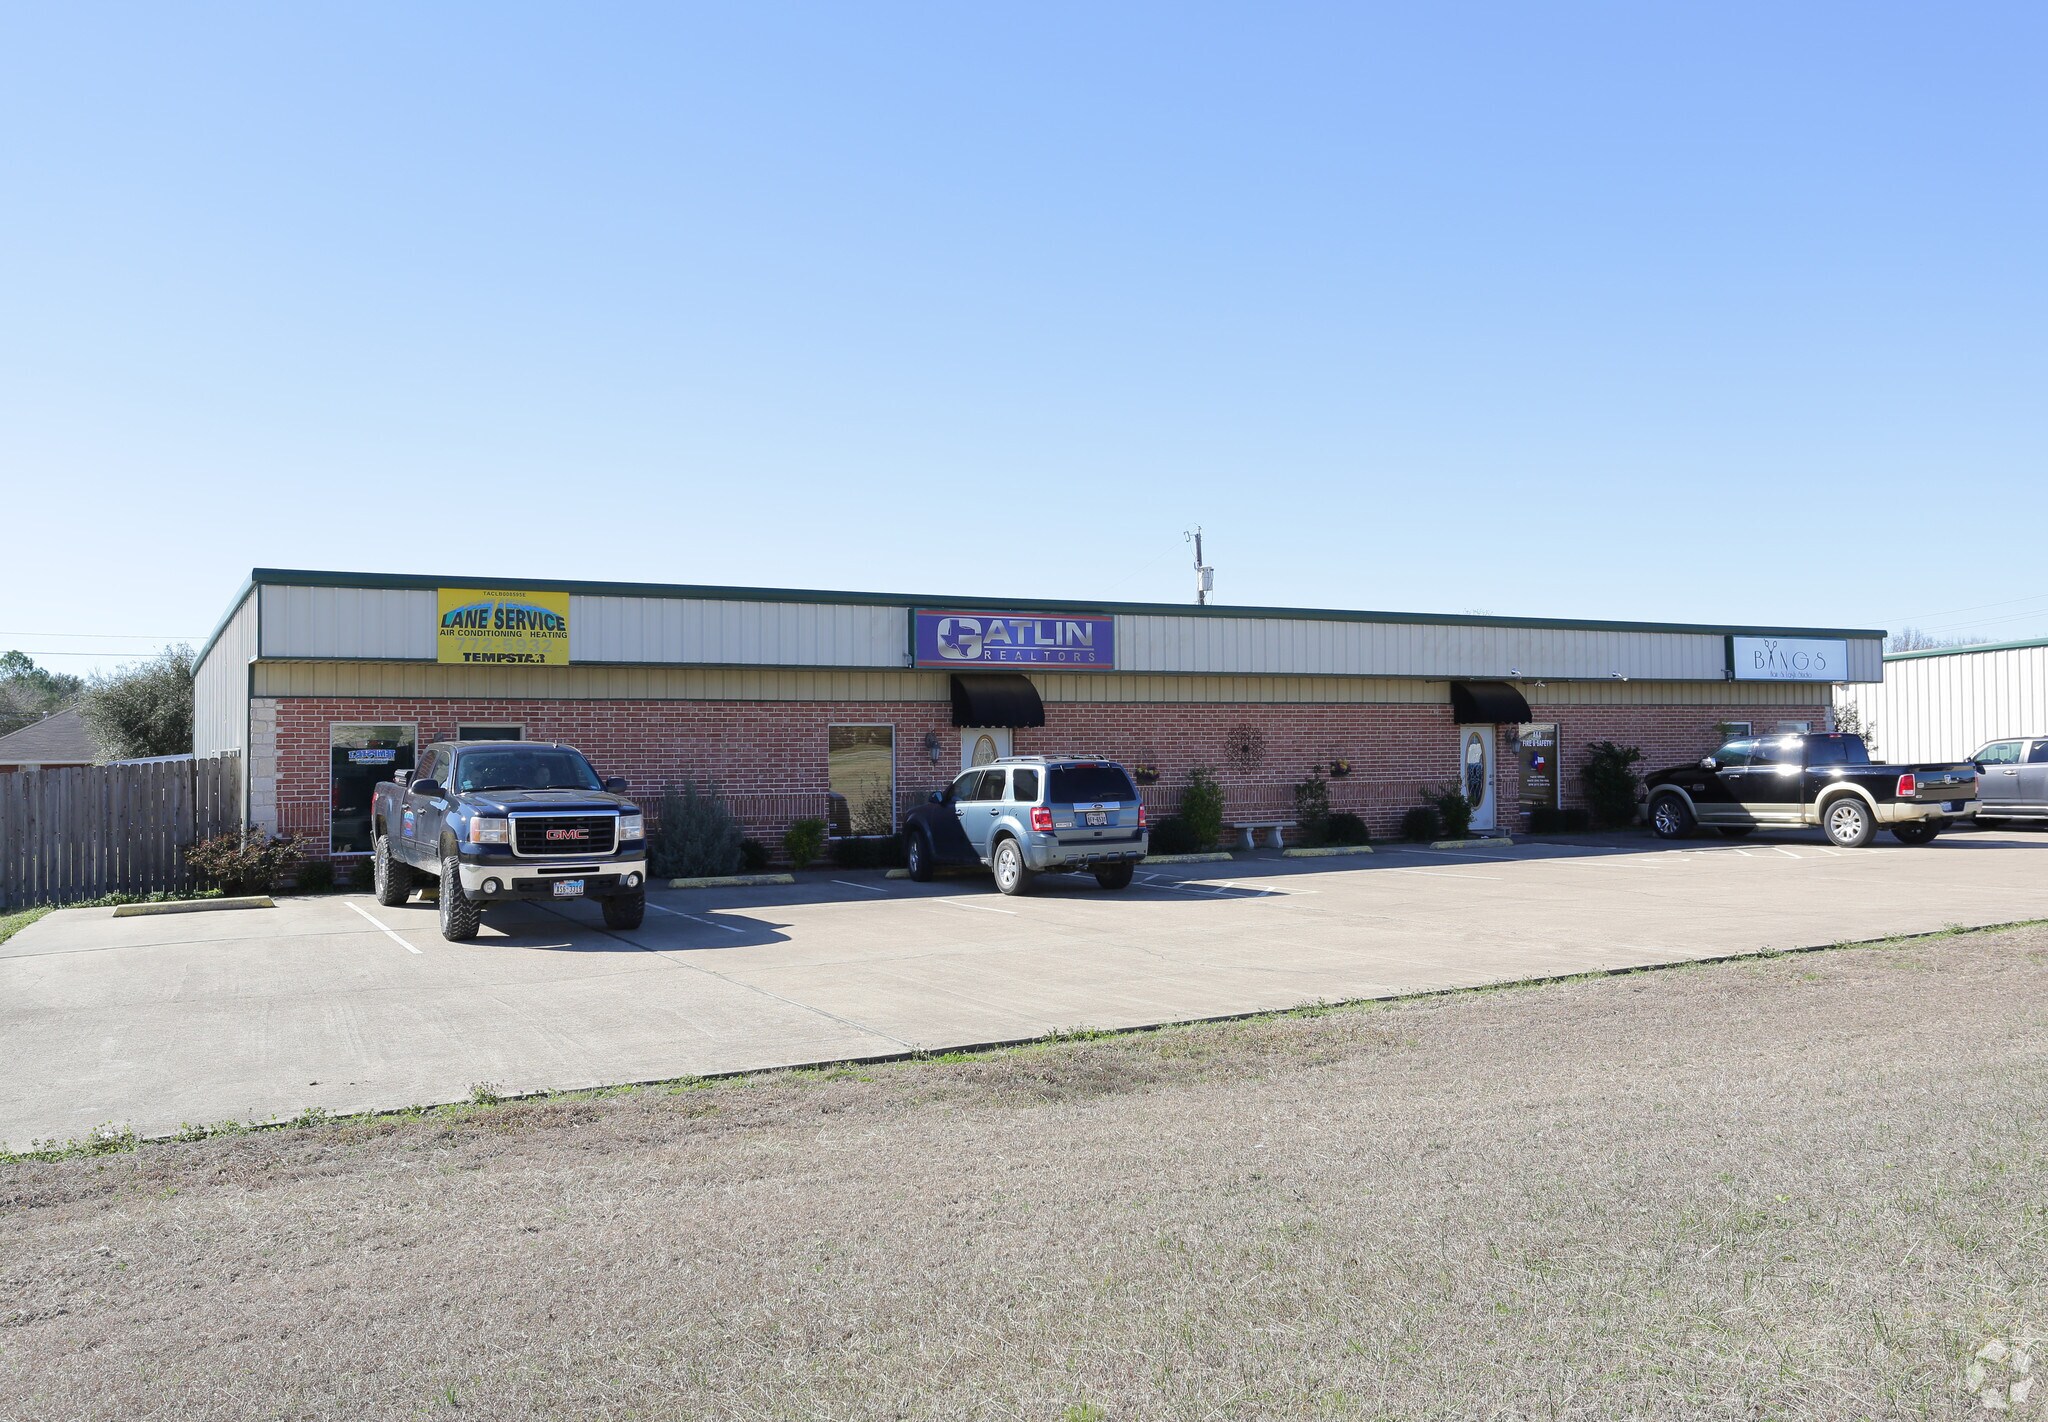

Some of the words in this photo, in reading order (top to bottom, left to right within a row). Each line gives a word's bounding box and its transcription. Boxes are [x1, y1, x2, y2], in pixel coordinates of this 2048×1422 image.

[441, 608, 489, 629] LANE
[494, 607, 566, 632] SERVICE
[457, 629, 522, 638] CONDITIONING
[530, 631, 568, 639] HEATING
[455, 637, 553, 652] 772-5932
[984, 650, 1096, 662] REALTORS
[546, 828, 589, 840] GMC
